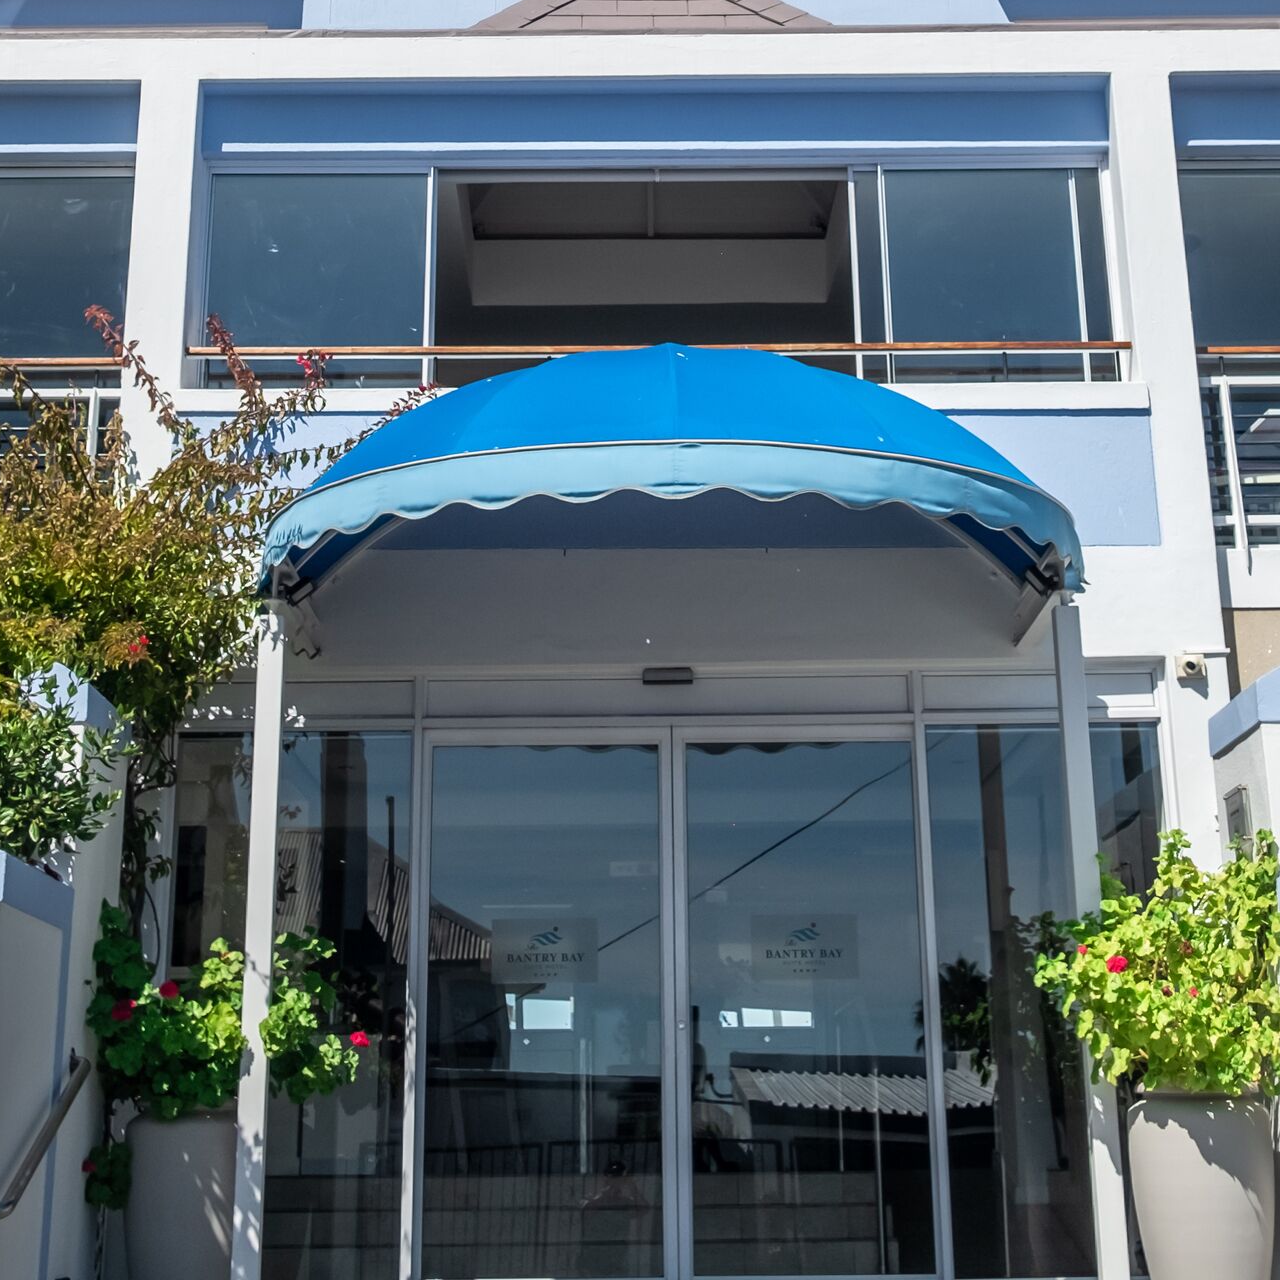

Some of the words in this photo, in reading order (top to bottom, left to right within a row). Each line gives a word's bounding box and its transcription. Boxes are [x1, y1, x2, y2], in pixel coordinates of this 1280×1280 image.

[507, 952, 557, 963] BANTRY
[561, 951, 585, 962] BAY
[766, 948, 815, 959] BANTRY
[819, 947, 843, 959] BAY
